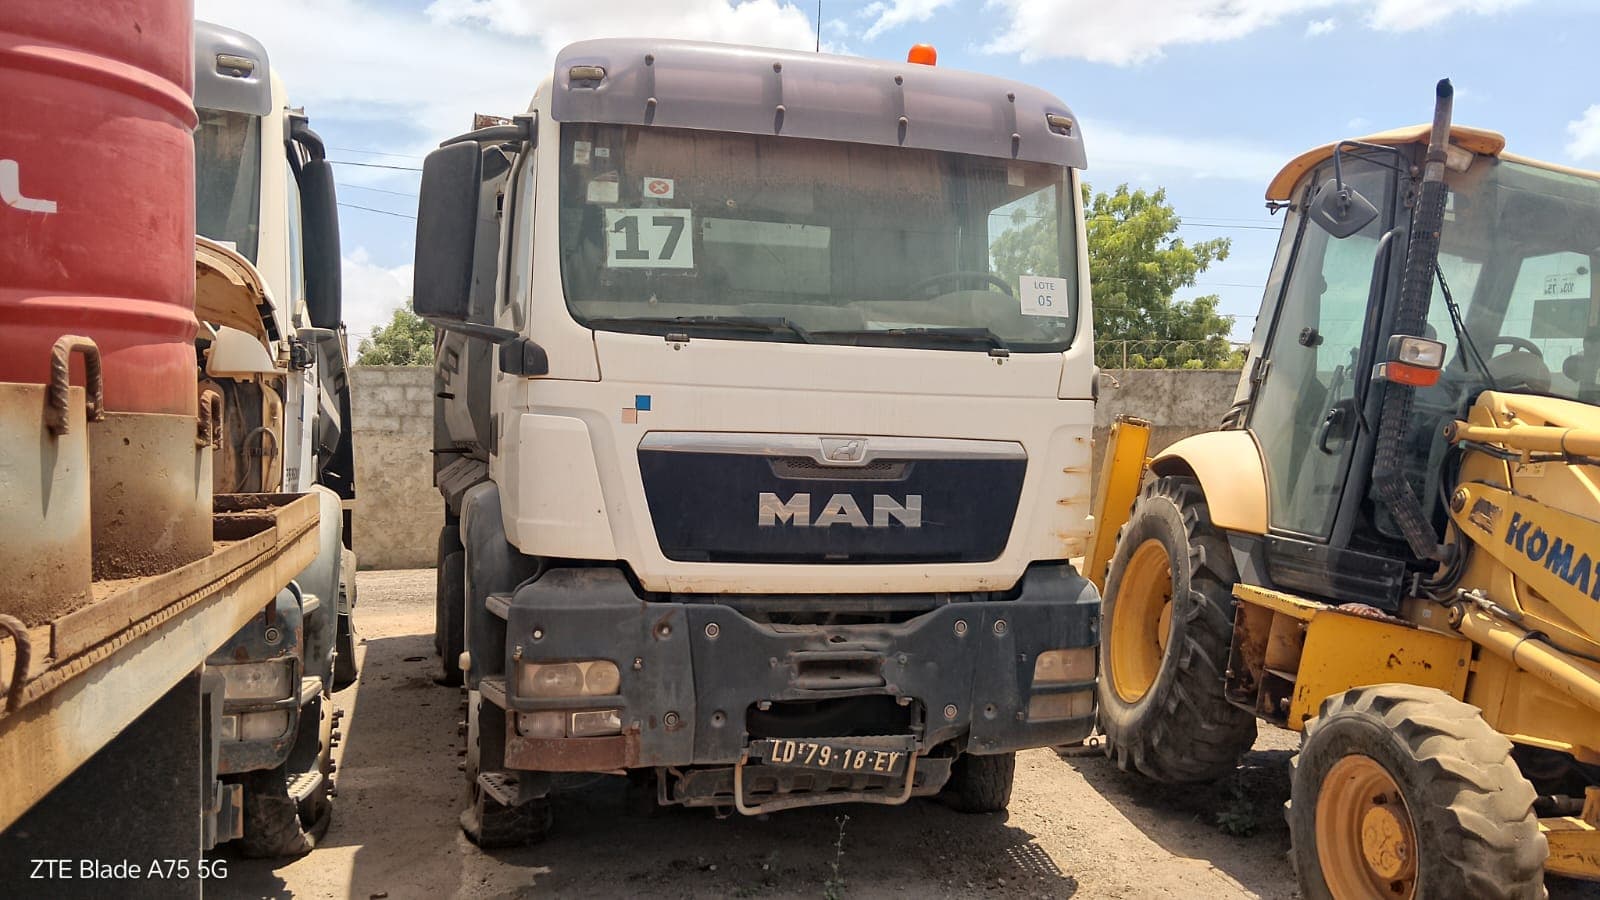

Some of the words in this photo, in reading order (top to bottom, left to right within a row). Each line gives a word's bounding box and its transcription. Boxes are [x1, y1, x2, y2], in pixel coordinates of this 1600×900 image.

[611, 215, 685, 260] 17
[1034, 280, 1056, 291] LOTE
[1037, 294, 1052, 307] 05
[758, 492, 922, 528] MAN
